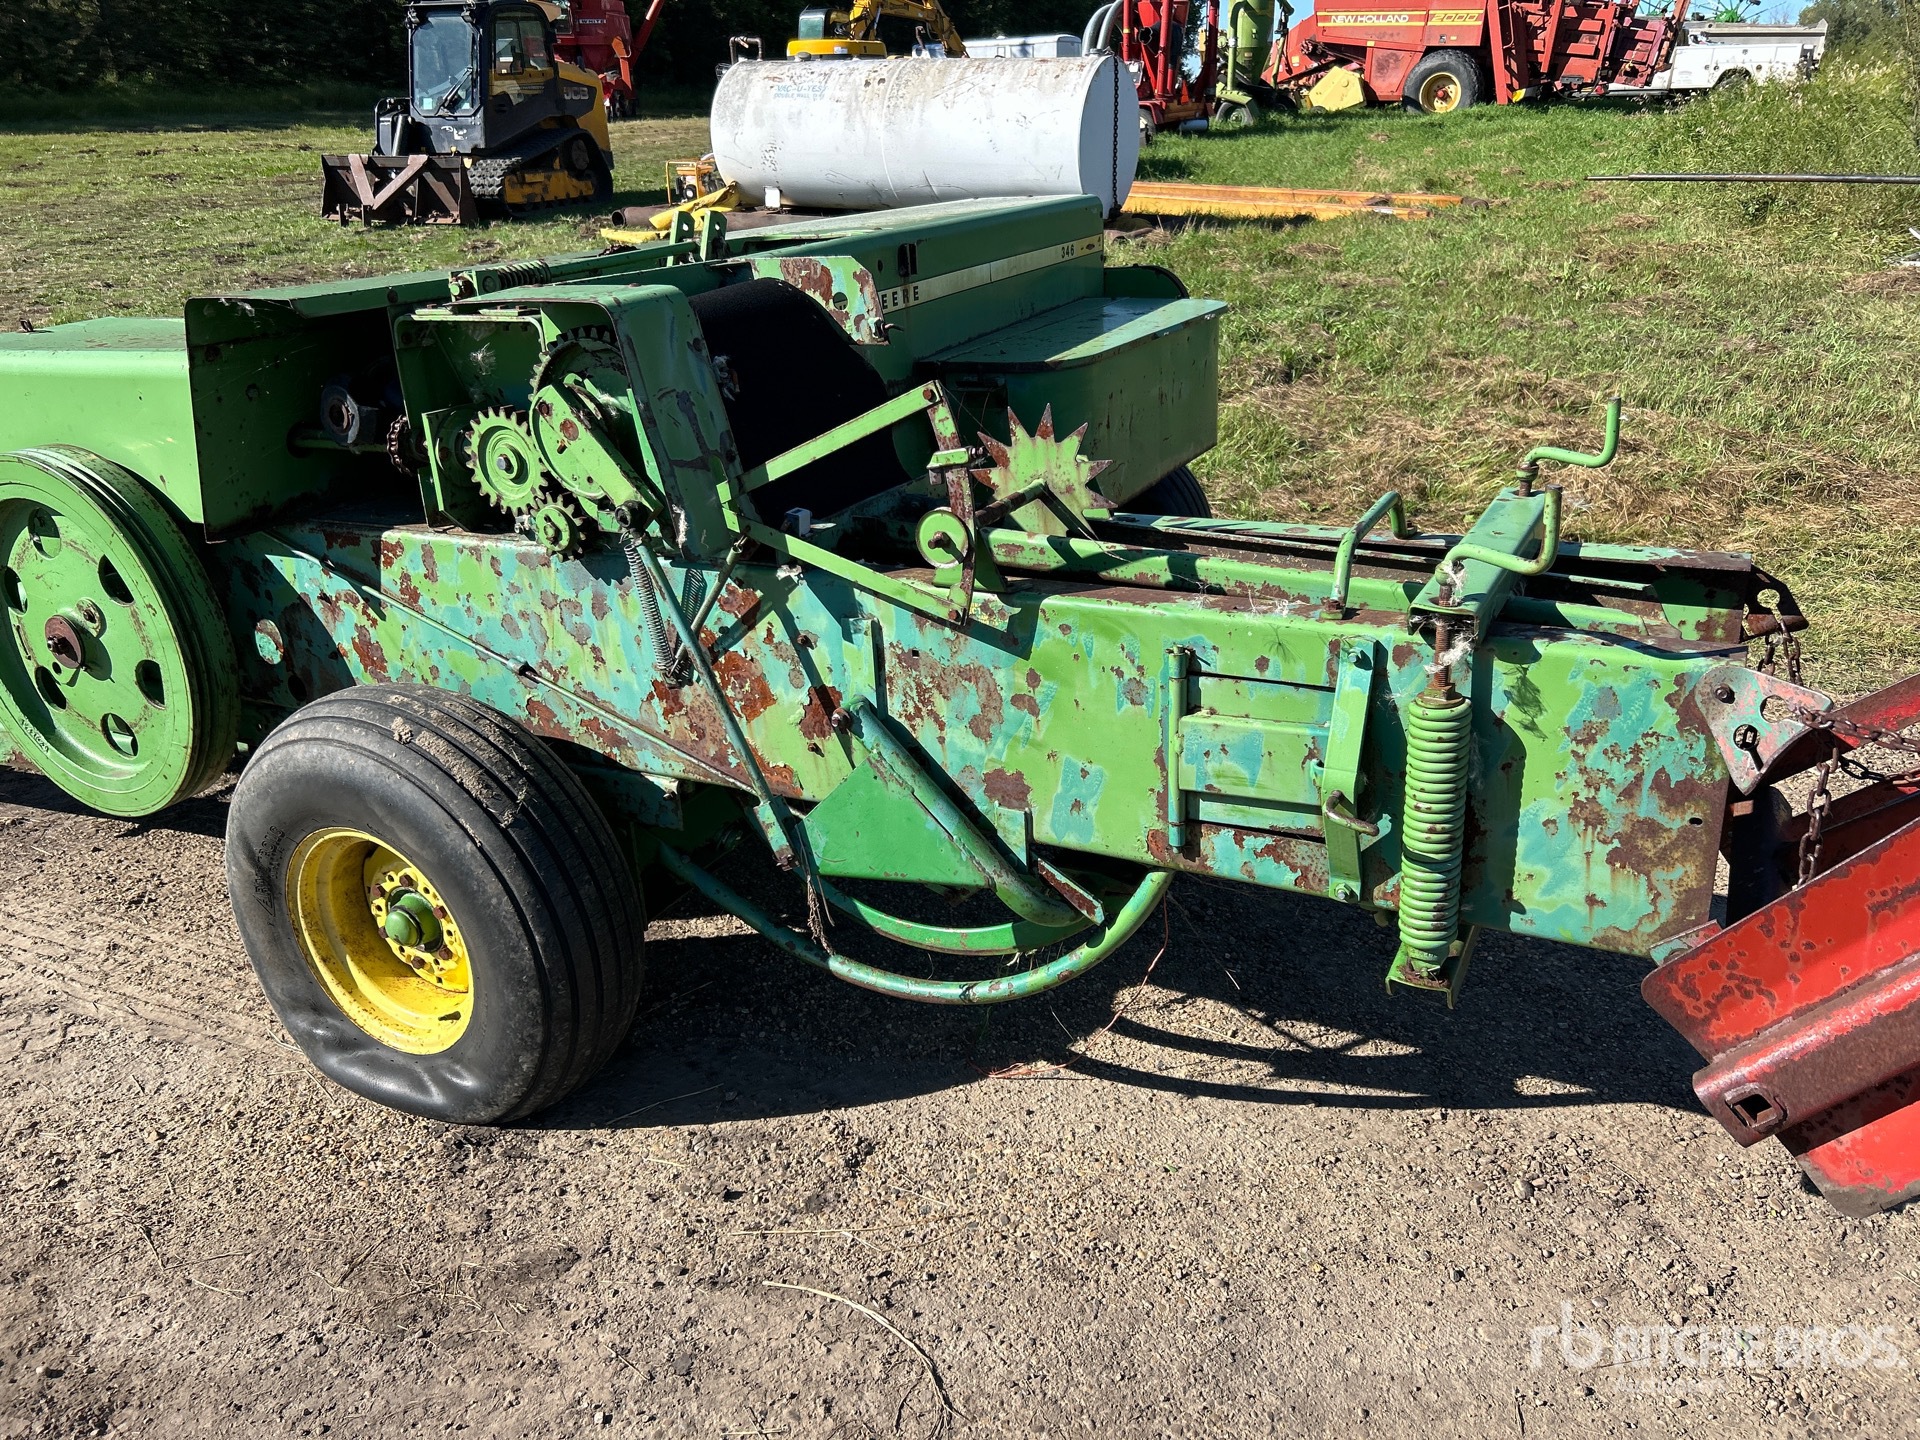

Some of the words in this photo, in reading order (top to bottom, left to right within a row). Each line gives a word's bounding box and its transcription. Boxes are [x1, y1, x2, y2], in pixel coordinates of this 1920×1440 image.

[1330, 15, 1356, 24] NEW
[1357, 14, 1410, 24] HOLLAND
[1431, 12, 1480, 22] 2000
[563, 86, 589, 100] JCB
[1060, 244, 1076, 259] 346
[881, 285, 920, 310] EERE
